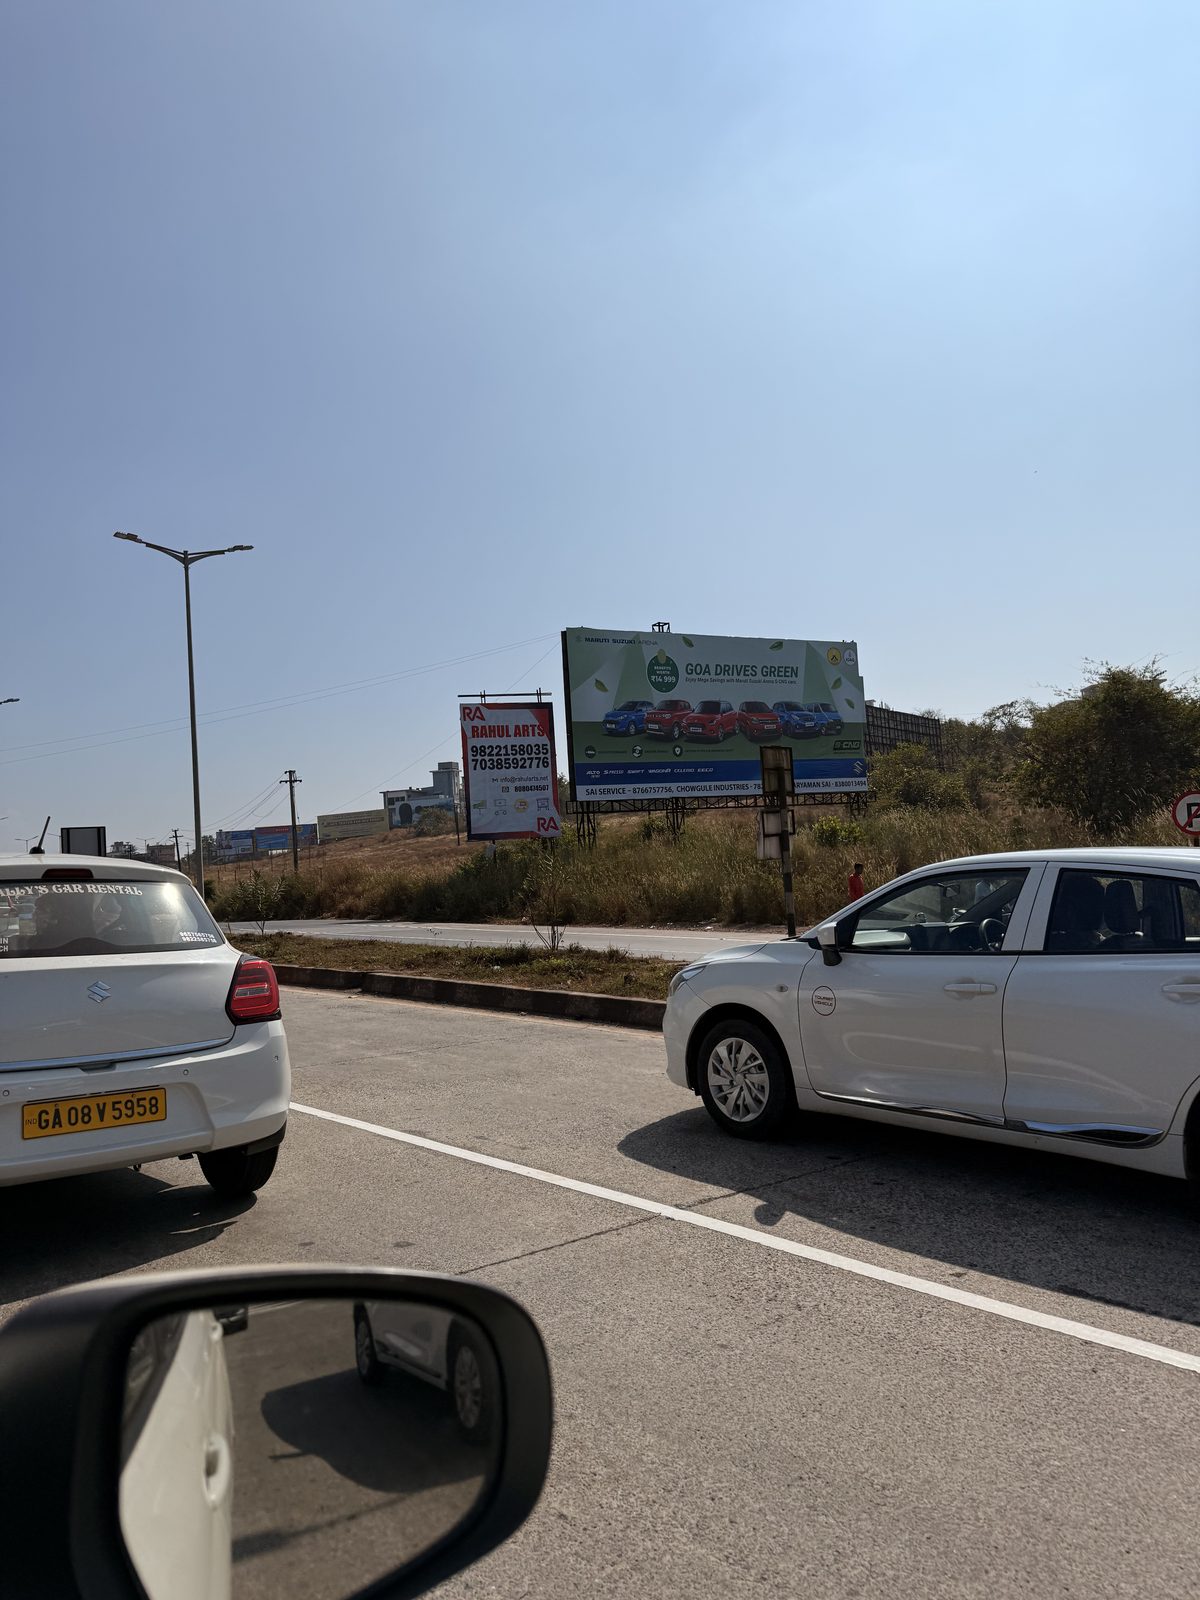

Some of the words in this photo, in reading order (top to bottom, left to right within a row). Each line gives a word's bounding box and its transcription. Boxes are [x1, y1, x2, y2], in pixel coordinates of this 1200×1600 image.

[685, 663, 711, 676] GOA
[715, 664, 757, 677] DRIVES
[761, 666, 799, 679] GREEN
[462, 706, 485, 721] RA
[471, 724, 511, 738] RAHUL
[513, 724, 544, 737] ARTS
[471, 744, 549, 757] 9822158035
[471, 757, 549, 771] 7038592776
[585, 788, 598, 796] SAI
[599, 787, 626, 795] SERVICE
[676, 784, 712, 793] CHOWGULE
[713, 783, 749, 791] INDUSTRIES
[538, 816, 560, 832] RA
[52, 884, 84, 894] CAR
[86, 884, 143, 896] RENTAL
[37, 1108, 63, 1130] GA
[67, 1104, 92, 1126] 08
[96, 1102, 107, 1122] V
[111, 1096, 159, 1121] 5958
